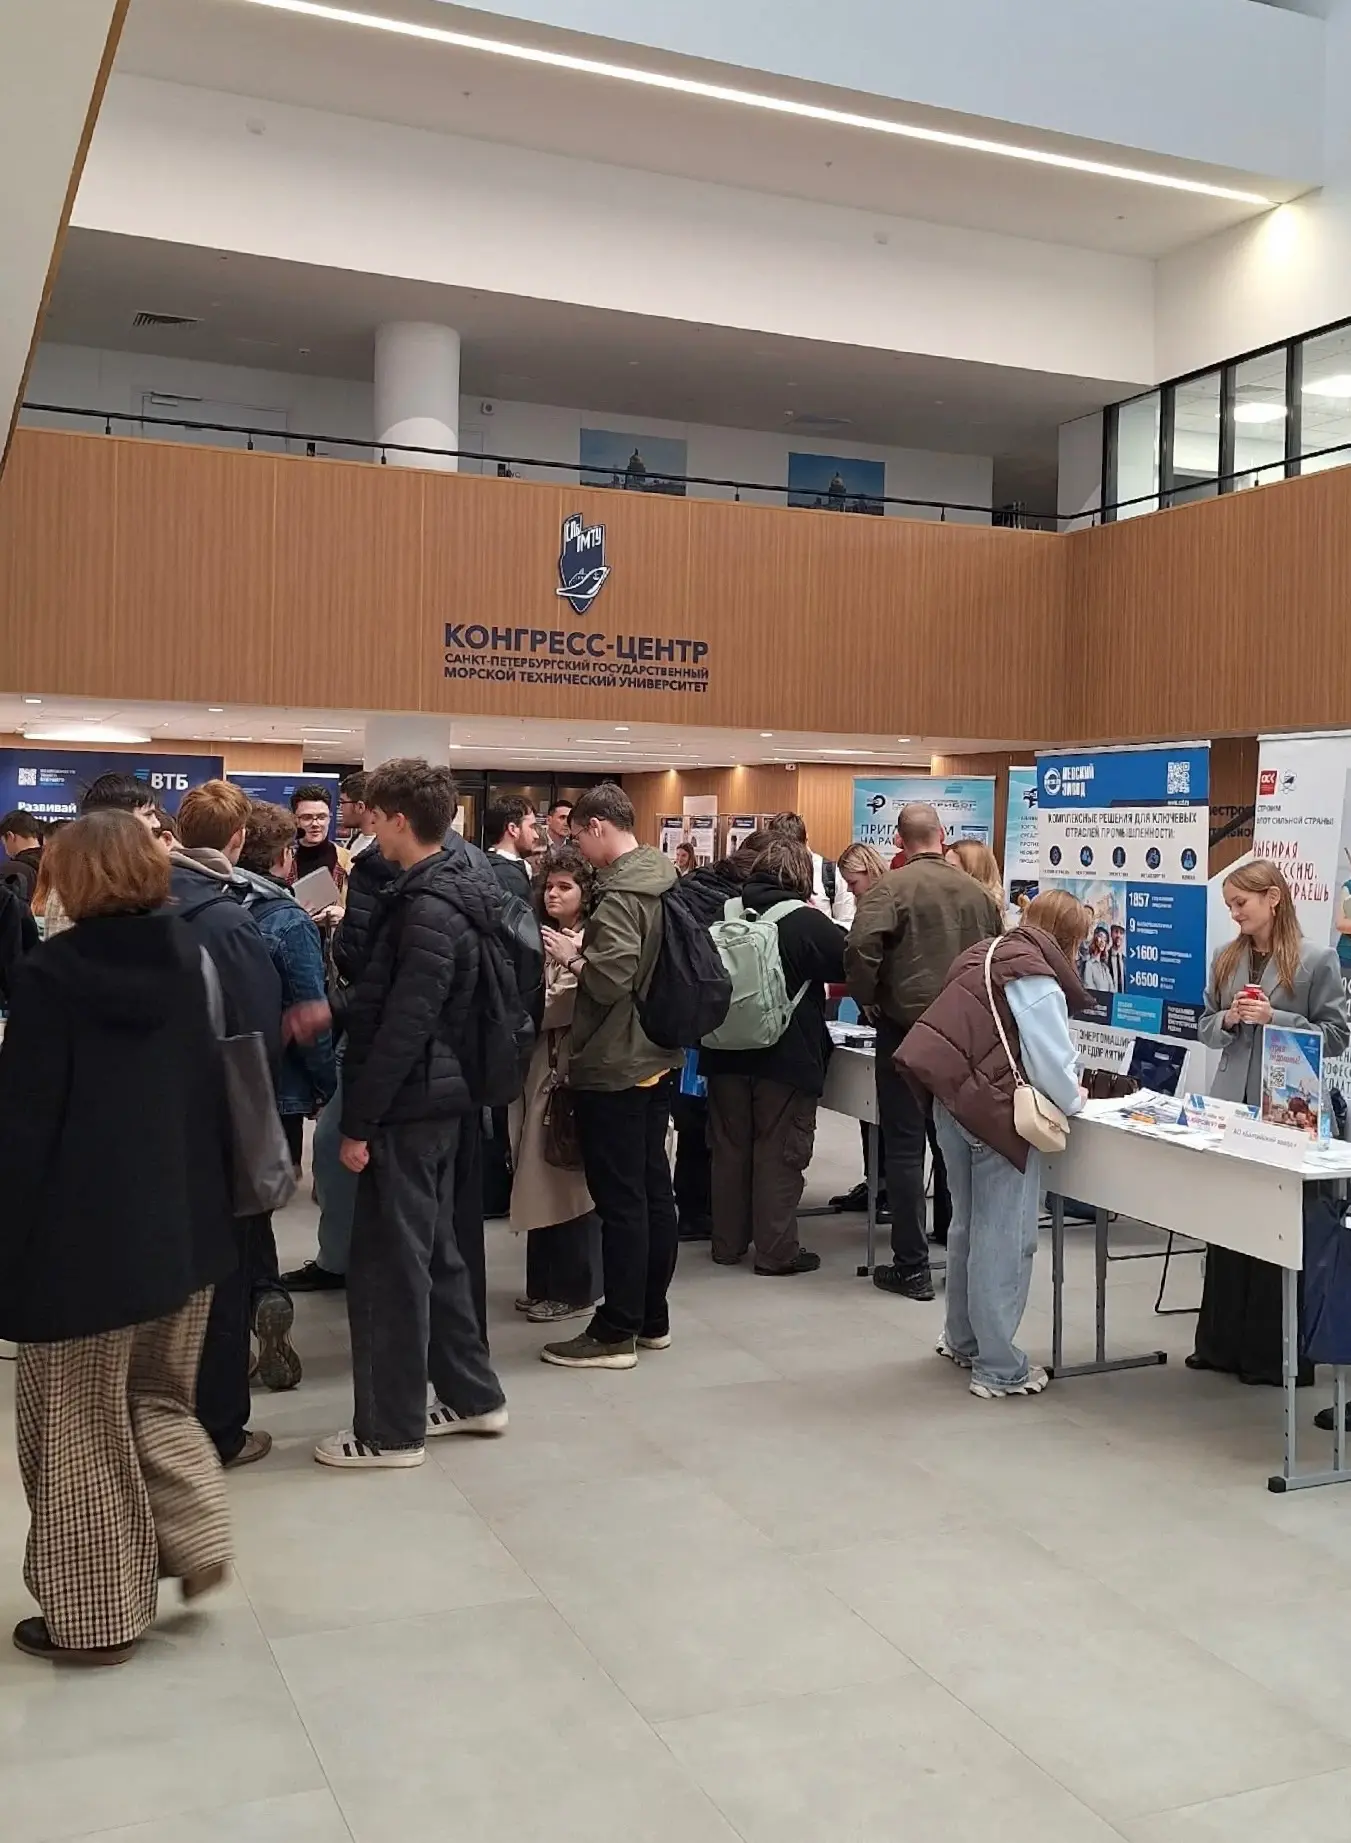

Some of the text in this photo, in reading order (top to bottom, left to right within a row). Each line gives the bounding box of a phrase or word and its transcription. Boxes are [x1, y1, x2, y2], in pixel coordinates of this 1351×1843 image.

[445, 622, 709, 664] КОНГРЕСС-ЦЕНТР
[445, 653, 709, 679] САНКТ-ПЕТЕРБУРГСКИЙ ГОСУДАРСТВЕННЫЙ
[444, 667, 709, 692] МОРСКОЙ ТЕХНИЧЕСКИЙ УНИВЕРСИТЕТ
[151, 772, 189, 790] ВТБ
[17, 801, 77, 813] Развивай
[1099, 813, 1133, 824] РЕШЕНИЯ
[1134, 813, 1151, 825] ДЛЯ
[1152, 812, 1197, 824] КЛЮЧЕВЫХ
[1253, 840, 1298, 858] ВЫБИРАЯ
[1129, 892, 1150, 908] 1857
[1129, 917, 1136, 932] 9
